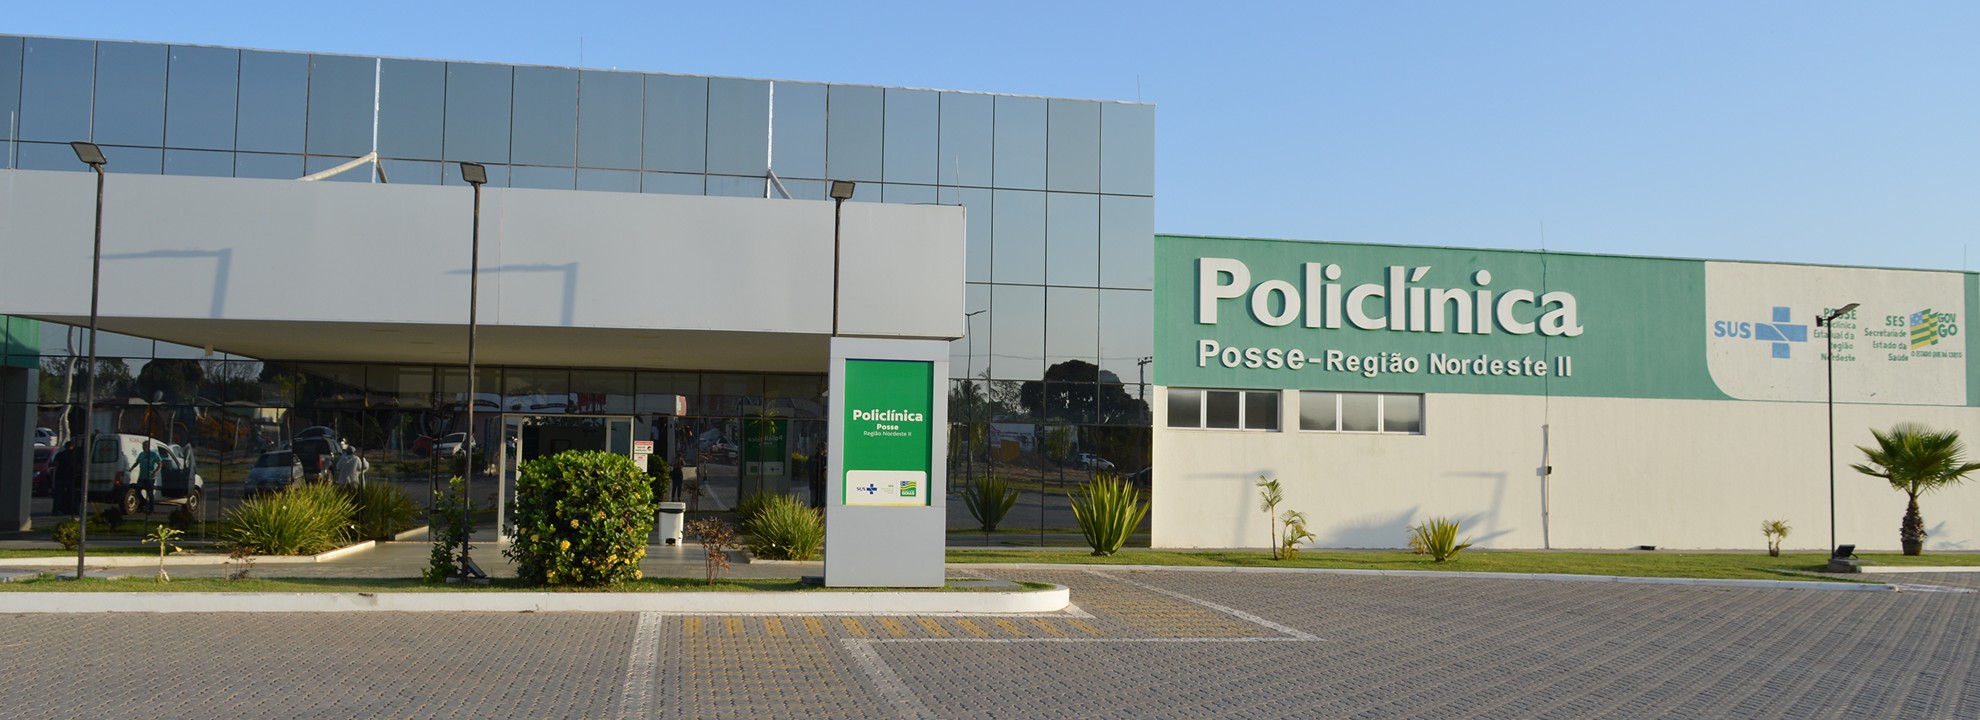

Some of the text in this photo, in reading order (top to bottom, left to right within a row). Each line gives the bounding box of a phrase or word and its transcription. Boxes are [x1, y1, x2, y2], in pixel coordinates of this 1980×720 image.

[1197, 257, 1584, 338] Policlínica
[1885, 315, 1905, 327] SES
[1937, 313, 1956, 324] GOV
[1713, 320, 1752, 339] SUS
[1813, 329, 1855, 340] Estaual da
[1937, 324, 1958, 338] GO
[1830, 341, 1854, 352] egião
[1872, 340, 1907, 350] Estado da
[1429, 352, 1547, 377] Nordeste
[1557, 356, 1572, 377] II
[853, 410, 923, 422] Policlínica
